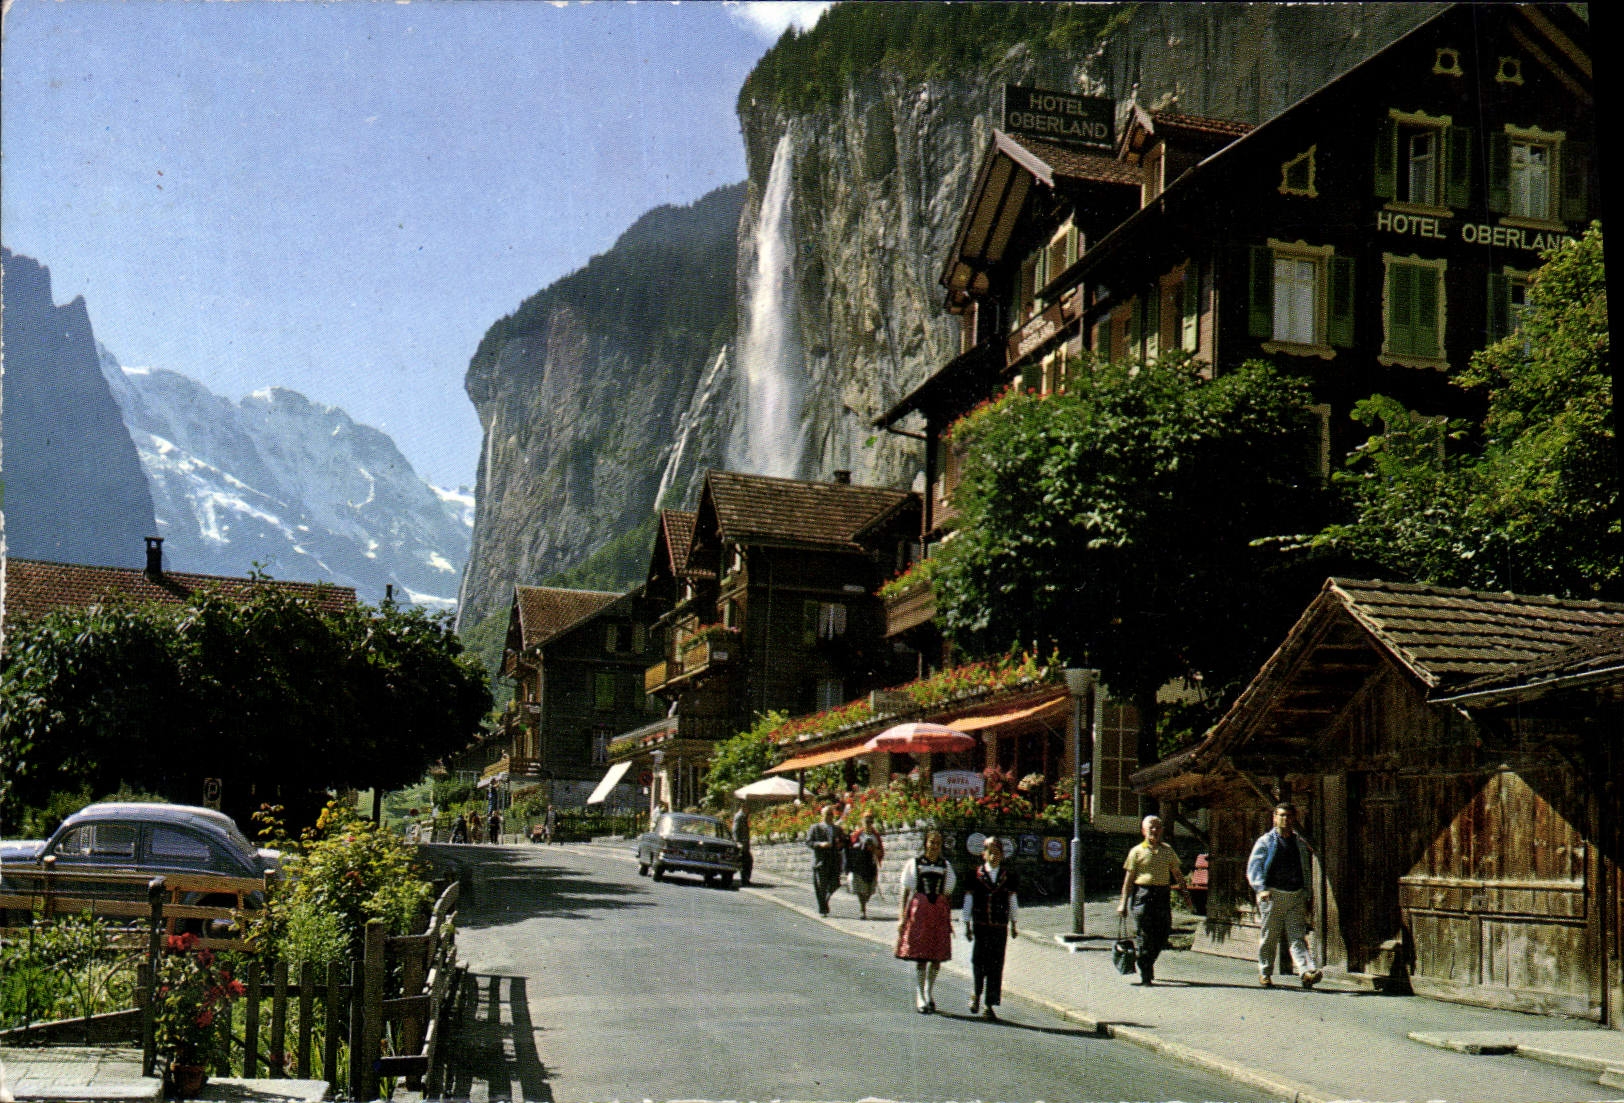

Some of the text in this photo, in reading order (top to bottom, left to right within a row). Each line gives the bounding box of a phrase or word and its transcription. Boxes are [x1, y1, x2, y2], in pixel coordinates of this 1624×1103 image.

[1029, 92, 1089, 117] HOTEL
[1009, 111, 1109, 140] OBERLAND
[1376, 210, 1447, 240] HOTEL
